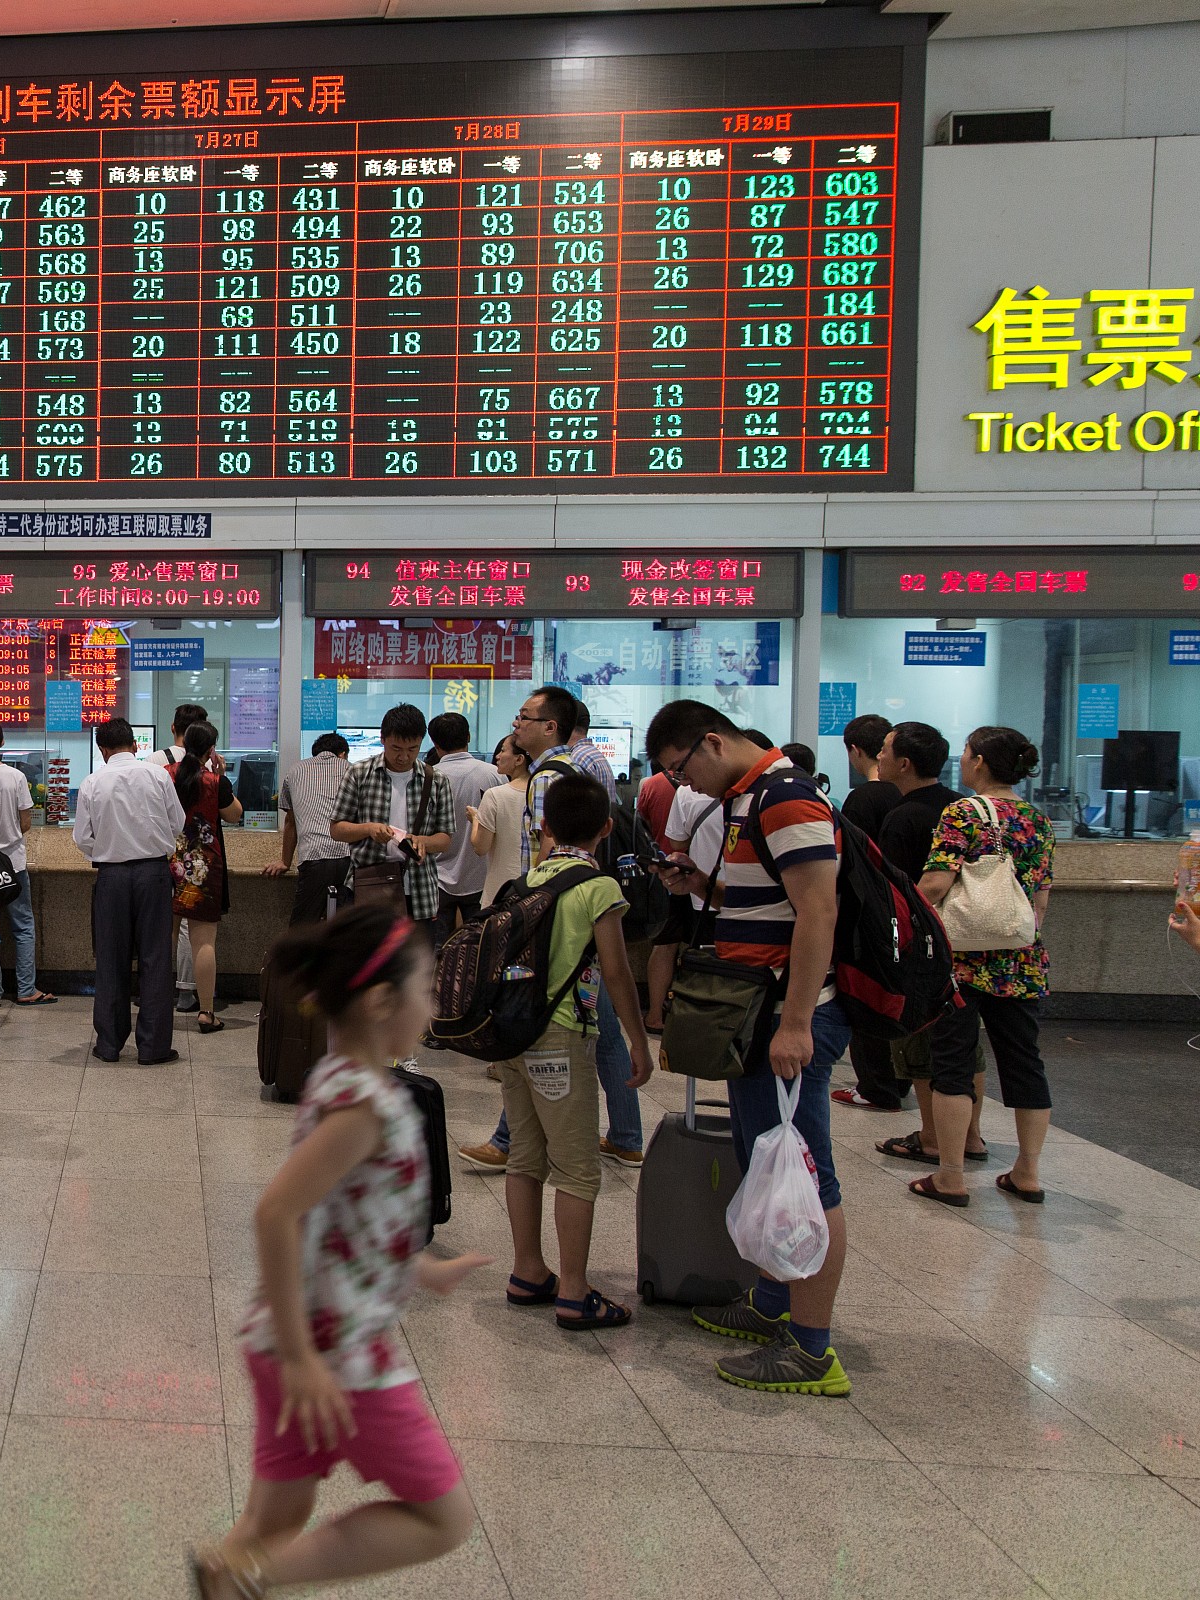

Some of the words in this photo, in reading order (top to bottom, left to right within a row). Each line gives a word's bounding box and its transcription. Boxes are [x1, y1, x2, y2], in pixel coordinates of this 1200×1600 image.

[195, 131, 257, 148] 7月27日
[455, 122, 520, 140] 7月28日
[723, 113, 792, 132] 7月29日
[51, 169, 83, 185] 二等
[109, 165, 196, 183] 商务座软卧
[224, 165, 259, 181] 一等
[303, 162, 338, 179] 二等
[365, 157, 455, 176] 商务座软卧
[484, 156, 520, 173] 一等
[566, 152, 602, 170] 二等
[630, 148, 724, 168] 商务座软卧
[753, 147, 791, 164] 一等
[839, 145, 876, 163] 二等
[39, 195, 85, 218] 462
[136, 193, 166, 214] 10
[217, 190, 264, 212] 118
[293, 188, 340, 210] 431
[392, 187, 423, 209] 10
[476, 184, 522, 207] 121
[554, 180, 605, 205] 534
[658, 178, 690, 200] 10
[745, 175, 795, 198] 123
[826, 172, 878, 196] 603
[972, 284, 1200, 391] 售票
[964, 411, 1122, 453] Ticket
[1133, 410, 1200, 453] Of
[37, 455, 82, 476] 575
[131, 453, 162, 474] 26
[219, 452, 250, 473] 80
[288, 452, 335, 473] 513
[385, 452, 417, 473] 26
[470, 451, 517, 472] 103
[548, 450, 596, 472] 571
[649, 447, 682, 469] 26
[737, 446, 786, 468] 132
[819, 444, 870, 468] 744
[73, 565, 96, 580] 95
[110, 561, 238, 582] 爱心售票窗口
[347, 562, 370, 578] 94
[395, 560, 530, 581] 值班主任窗口
[621, 559, 761, 581] 现金改签窗口
[566, 576, 590, 591] 93
[900, 574, 926, 591] 92
[940, 570, 1088, 593] 发售全国车票
[1183, 573, 1200, 591] 9
[57, 586, 260, 607] 工作时间8:00-19:00
[390, 585, 526, 606] 发售全国车票
[628, 586, 755, 606] 发售全国车票
[70, 634, 117, 646] 正在检票
[331, 632, 516, 665] 网络购票身份核验窗口
[70, 649, 117, 660] 正在检票
[618, 638, 763, 671] 自动售票专区
[70, 663, 117, 675] 正在检票
[82, 679, 117, 691] 在检票
[82, 695, 117, 706] 在检票
